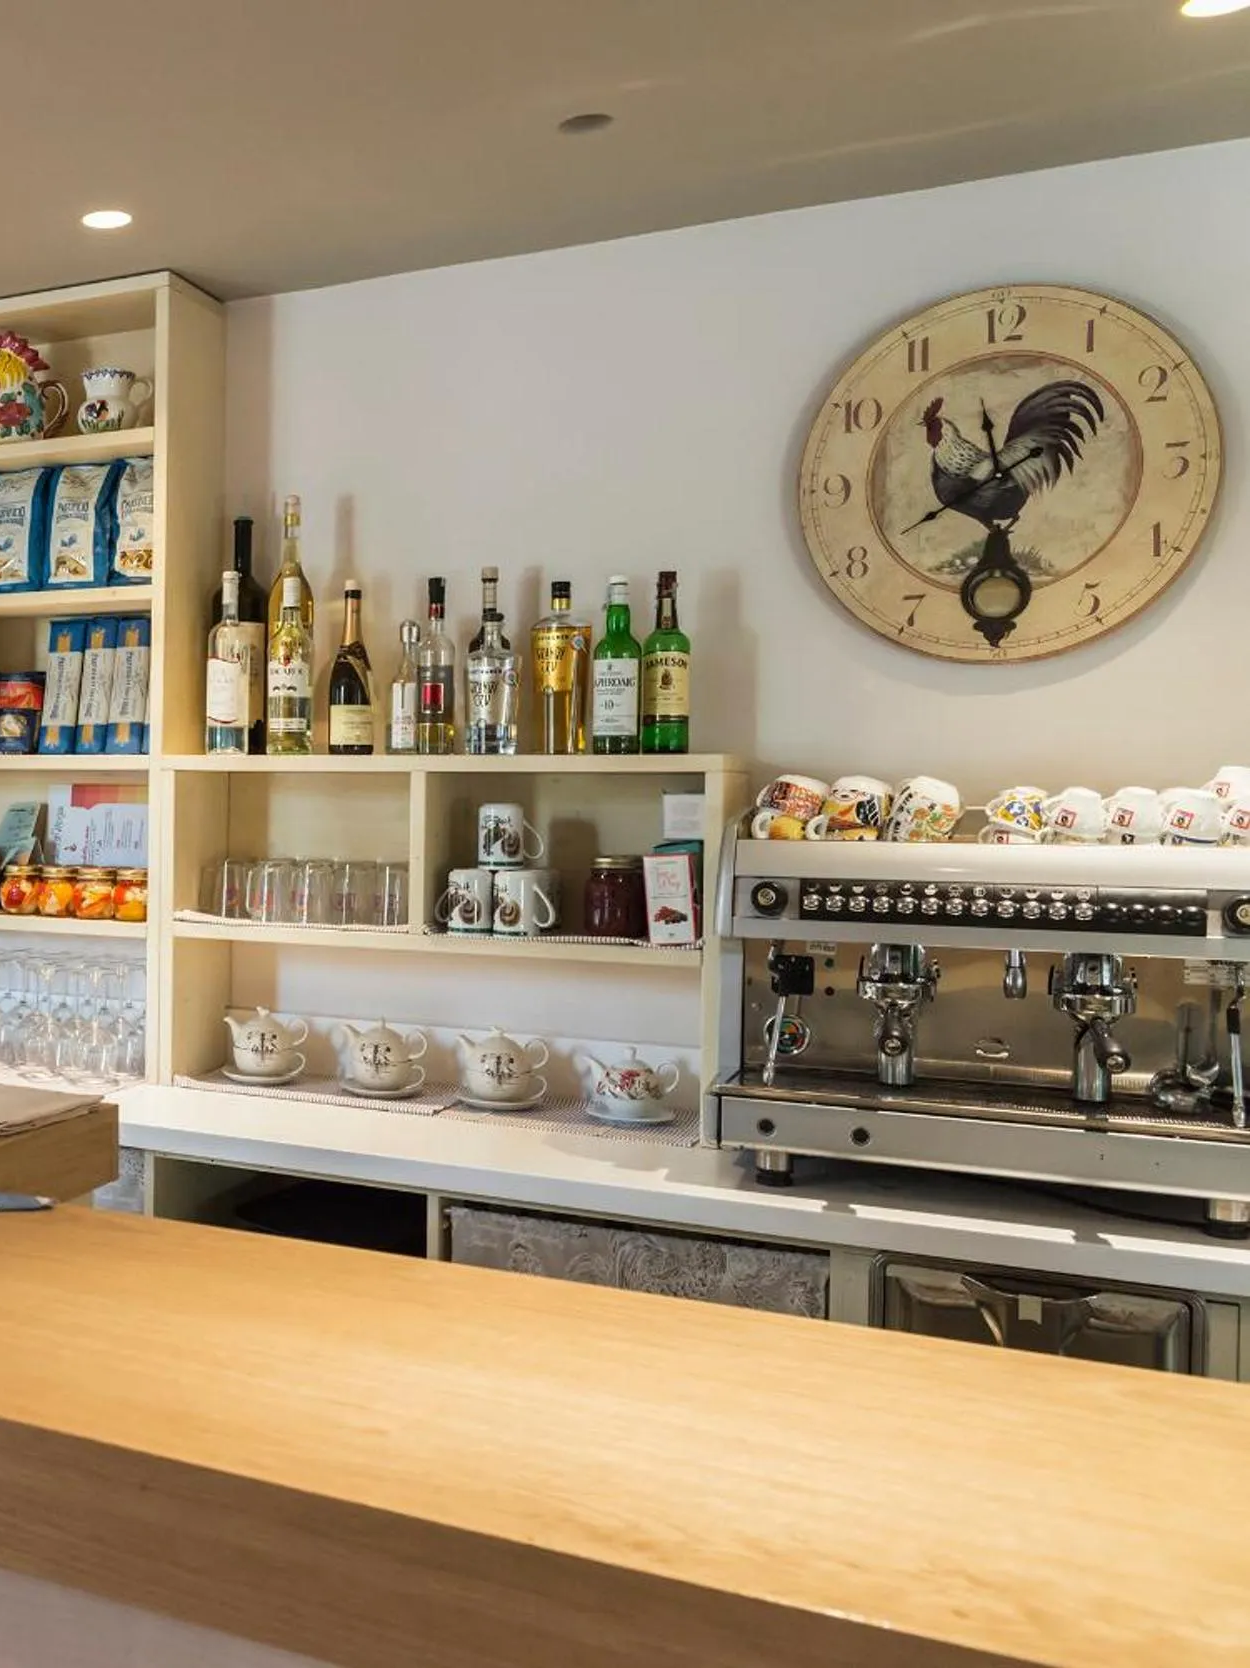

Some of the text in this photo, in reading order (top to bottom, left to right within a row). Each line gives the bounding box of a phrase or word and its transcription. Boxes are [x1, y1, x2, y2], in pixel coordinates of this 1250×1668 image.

[986, 304, 1027, 344] 12
[1085, 319, 1095, 353] 1
[907, 336, 930, 373] 11
[1138, 365, 1169, 403] 2
[843, 397, 883, 434] 10
[822, 473, 852, 510] 9
[845, 546, 870, 580] 8
[902, 593, 927, 628] 7
[1075, 582, 1101, 618] 5
[645, 656, 688, 671] JAMESON
